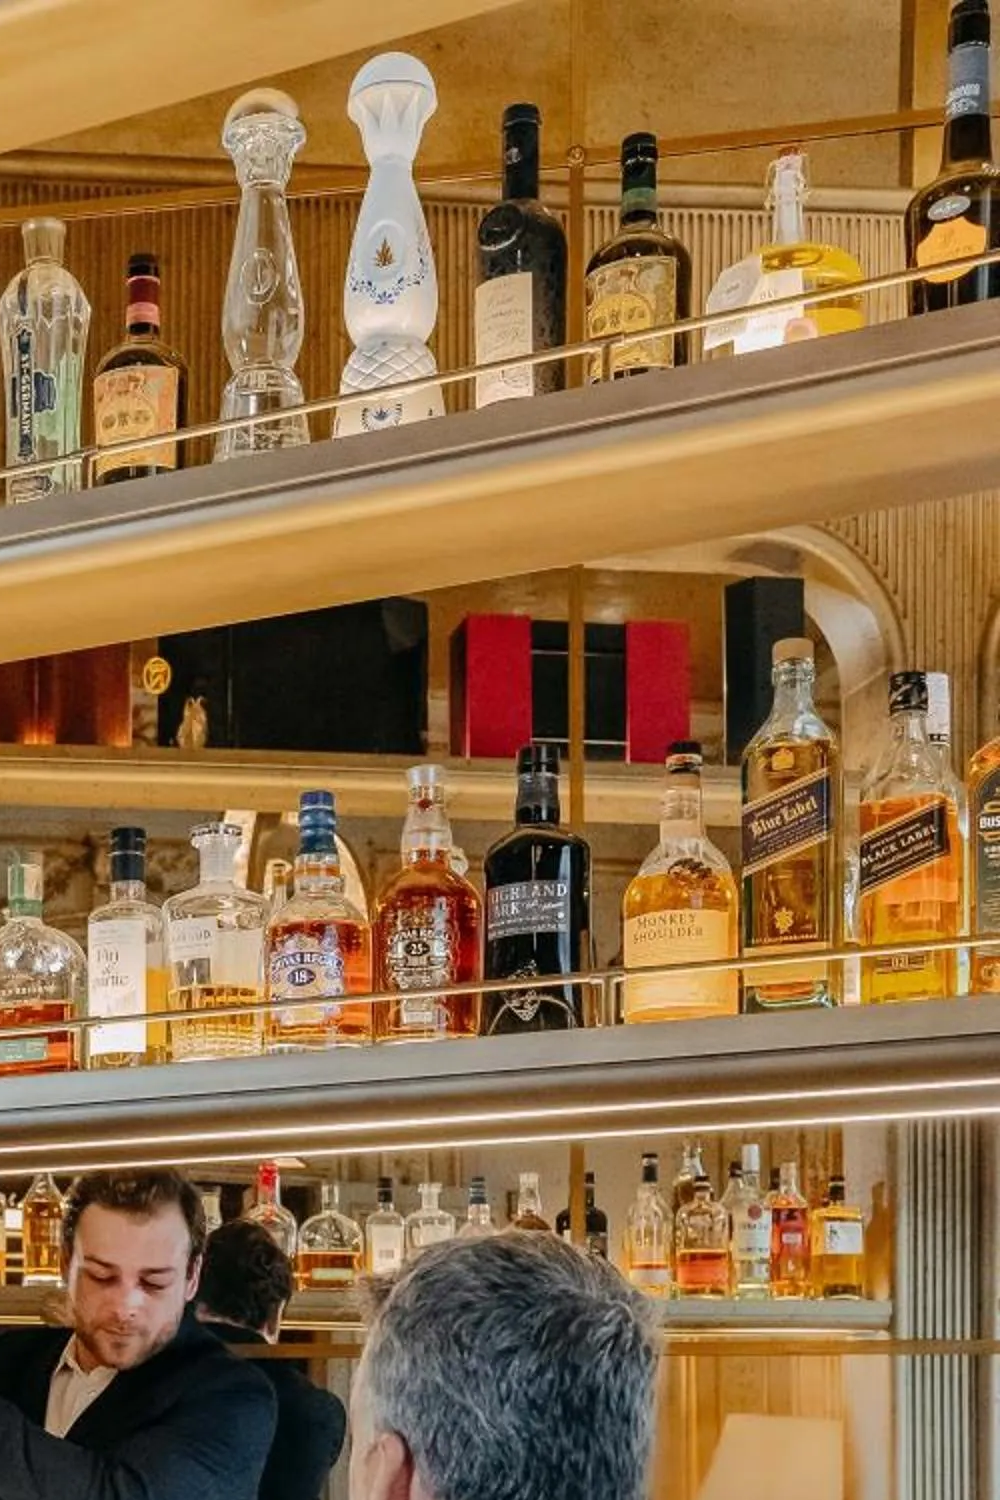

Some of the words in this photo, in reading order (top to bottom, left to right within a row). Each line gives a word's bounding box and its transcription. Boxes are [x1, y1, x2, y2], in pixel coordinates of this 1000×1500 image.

[752, 814, 782, 840] Blue
[780, 796, 818, 824] Label
[861, 841, 899, 867] BLACK
[899, 824, 938, 848] LABEL
[636, 911, 698, 930] MONKEY
[632, 926, 704, 945] SHOULDER
[410, 943, 424, 955] 25
[294, 970, 308, 983] 18
